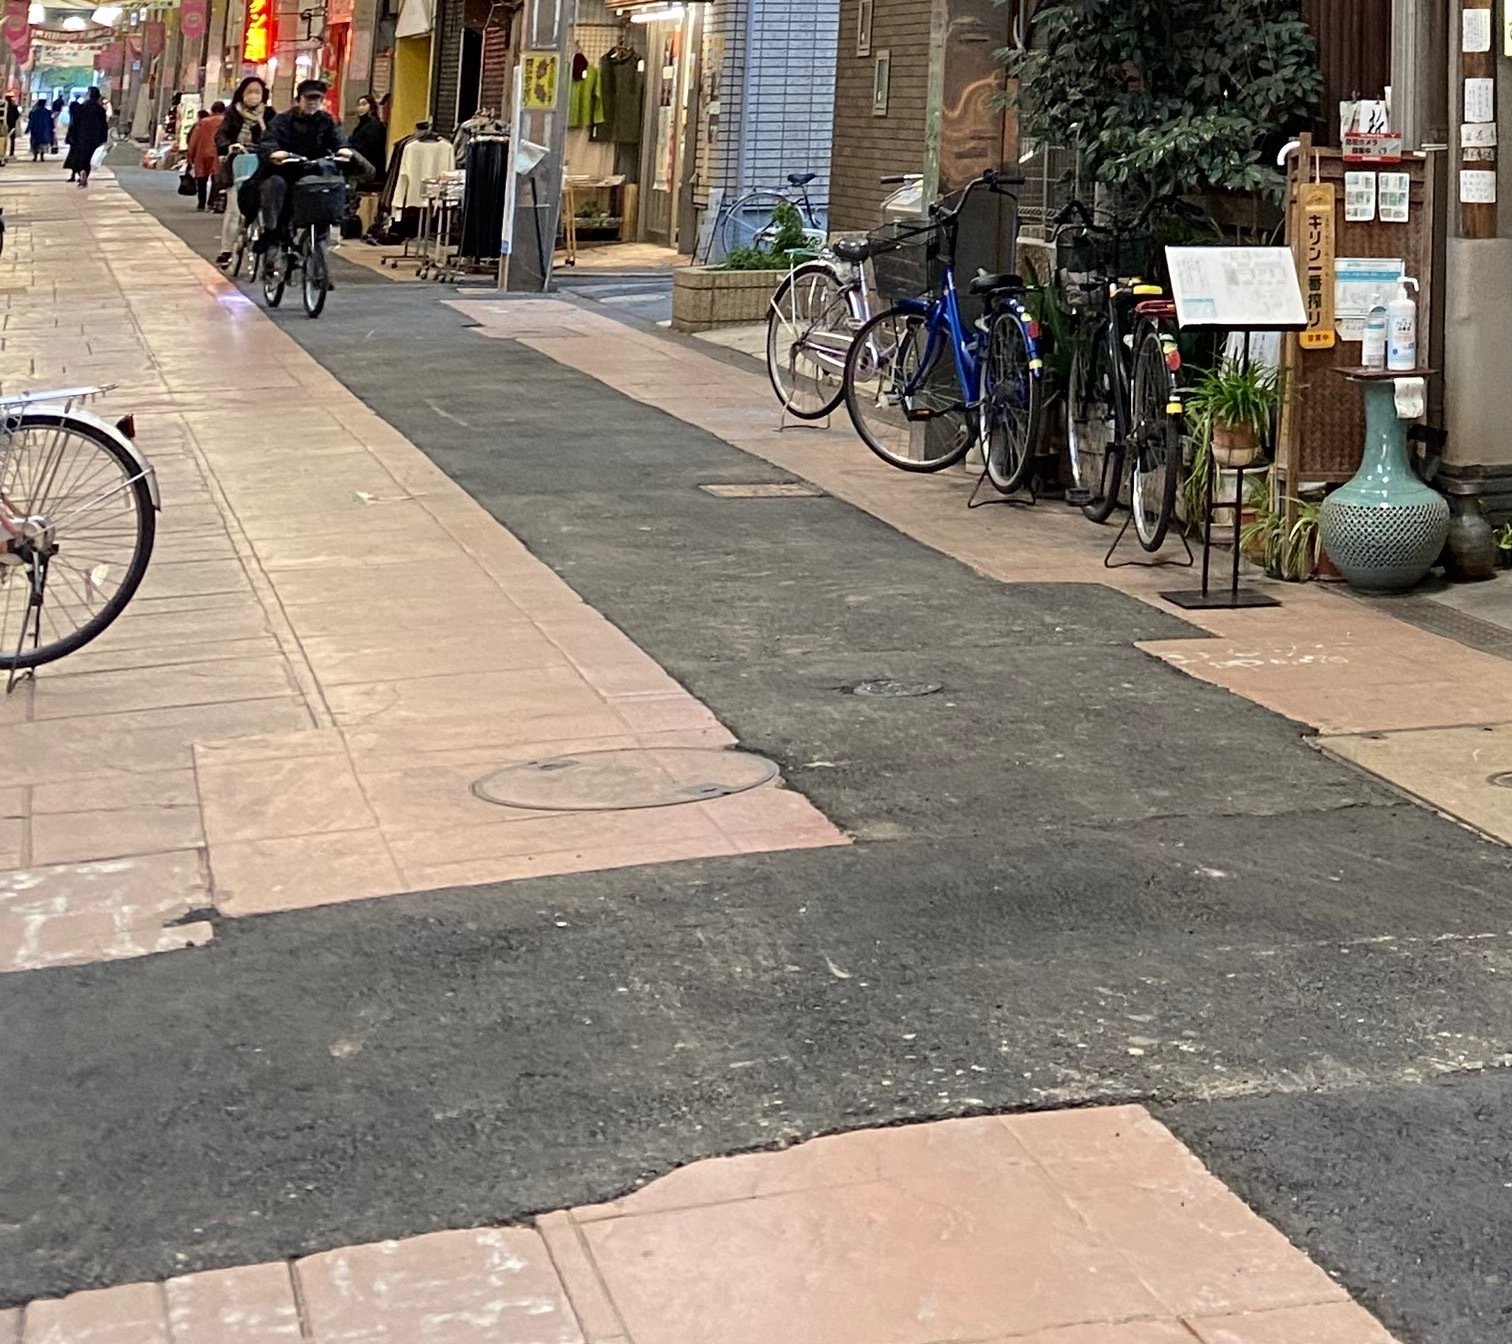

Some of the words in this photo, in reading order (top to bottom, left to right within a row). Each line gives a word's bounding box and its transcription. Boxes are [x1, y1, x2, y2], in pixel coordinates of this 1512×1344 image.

[1307, 214, 1323, 328] キリン一番搾り
